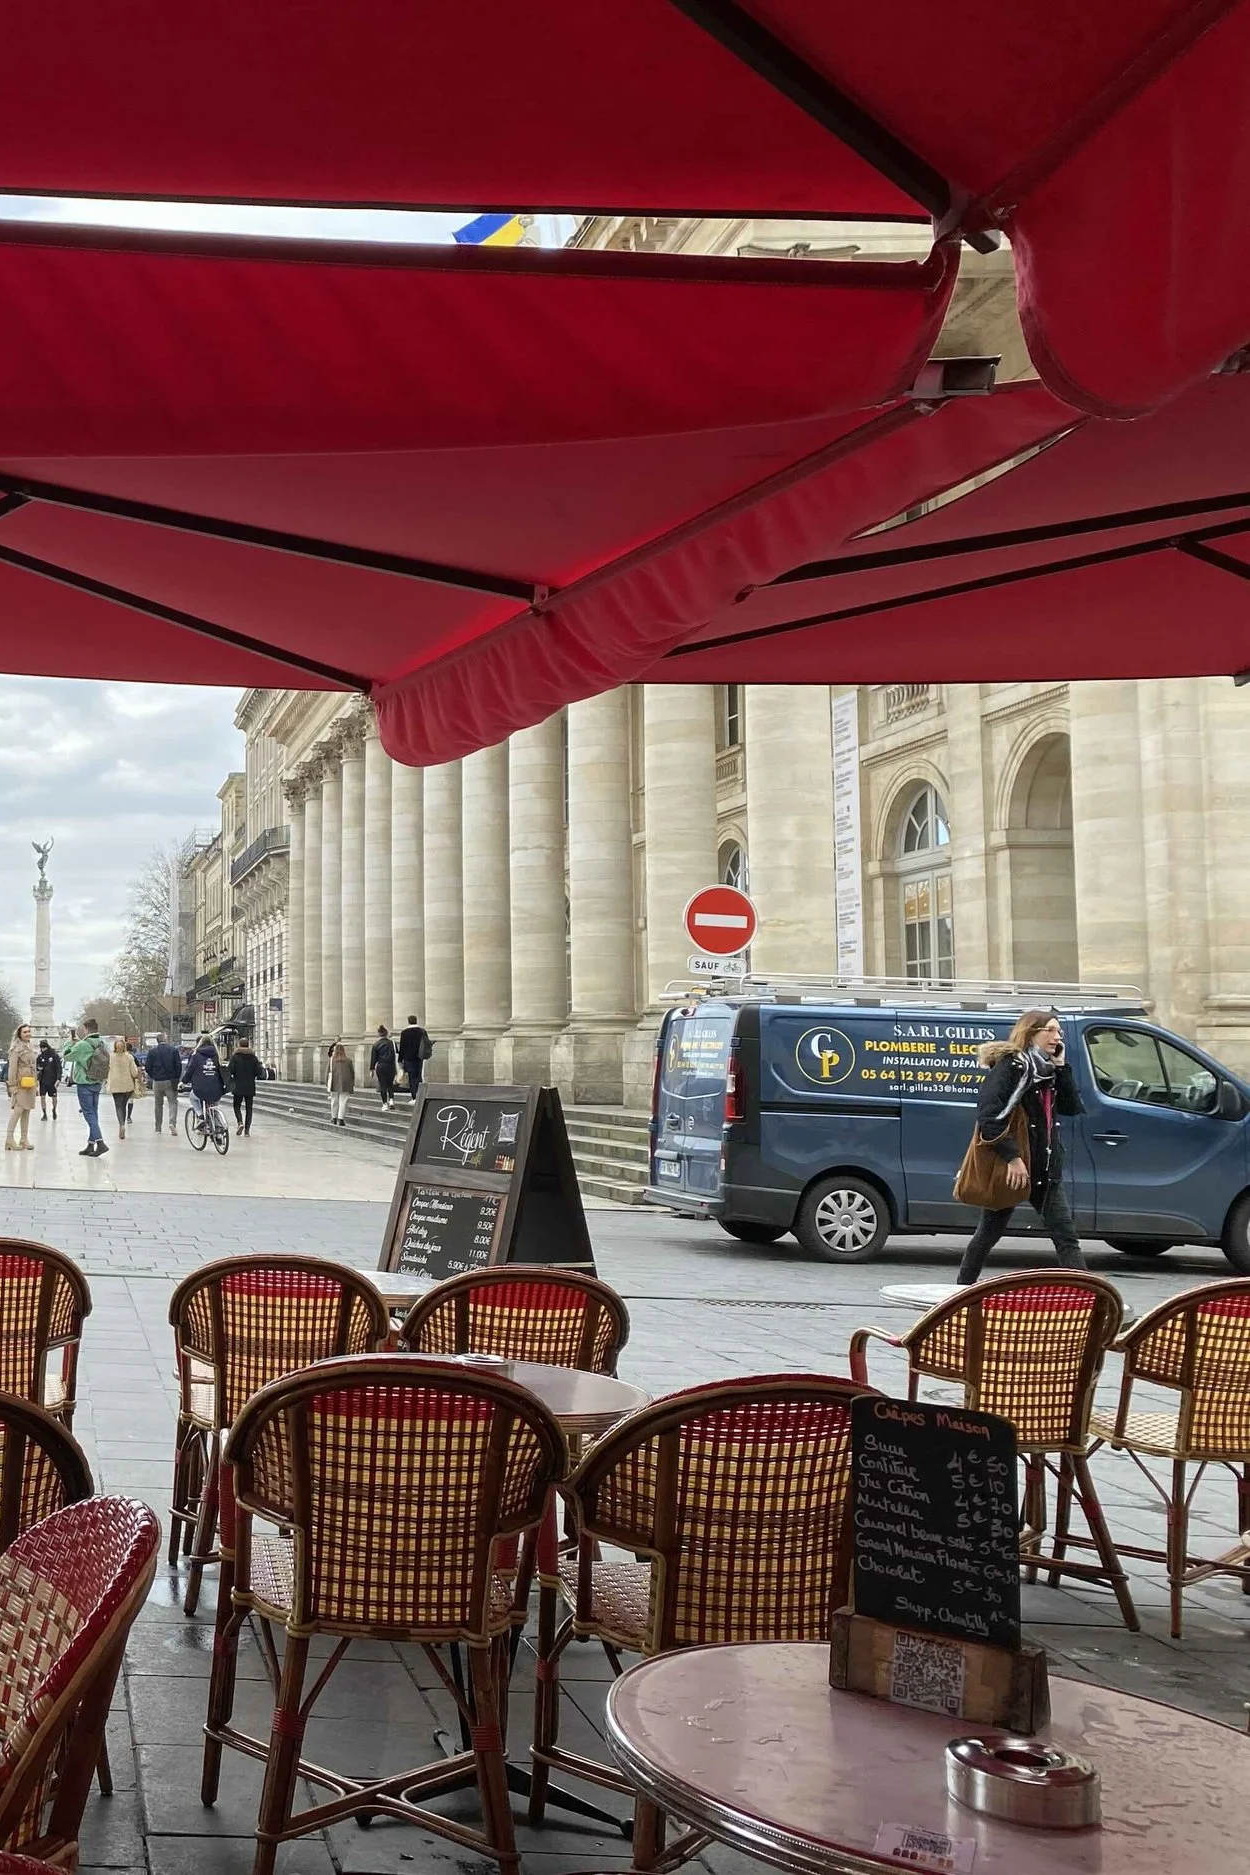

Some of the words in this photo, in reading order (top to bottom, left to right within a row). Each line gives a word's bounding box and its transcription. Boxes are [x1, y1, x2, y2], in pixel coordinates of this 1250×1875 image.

[694, 961, 720, 970] SAUF
[945, 1026, 996, 1040] GILLES
[864, 1040, 937, 1053] PLOMBERIE
[949, 1040, 978, 1055] ÉLEC
[882, 1056, 949, 1067] INSTALLATION
[952, 1057, 979, 1069] DÉPA
[861, 1068, 877, 1079] 05
[880, 1070, 895, 1080] 64
[900, 1070, 914, 1080] 12
[917, 1071, 933, 1081] 82
[935, 1072, 951, 1082] 97
[960, 1074, 973, 1083] 07
[889, 1083, 979, 1093] sarl.gilles33@hotma
[436, 1104, 491, 1166] Régent
[874, 1401, 926, 1428] Crêpes
[936, 1412, 991, 1441] Maison
[864, 1433, 908, 1458] Sucre
[858, 1472, 882, 1490] Jus
[887, 1479, 931, 1504] Citron
[857, 1493, 924, 1520] Nutella
[854, 1509, 906, 1537] Caramel
[857, 1555, 926, 1584] Chocolat
